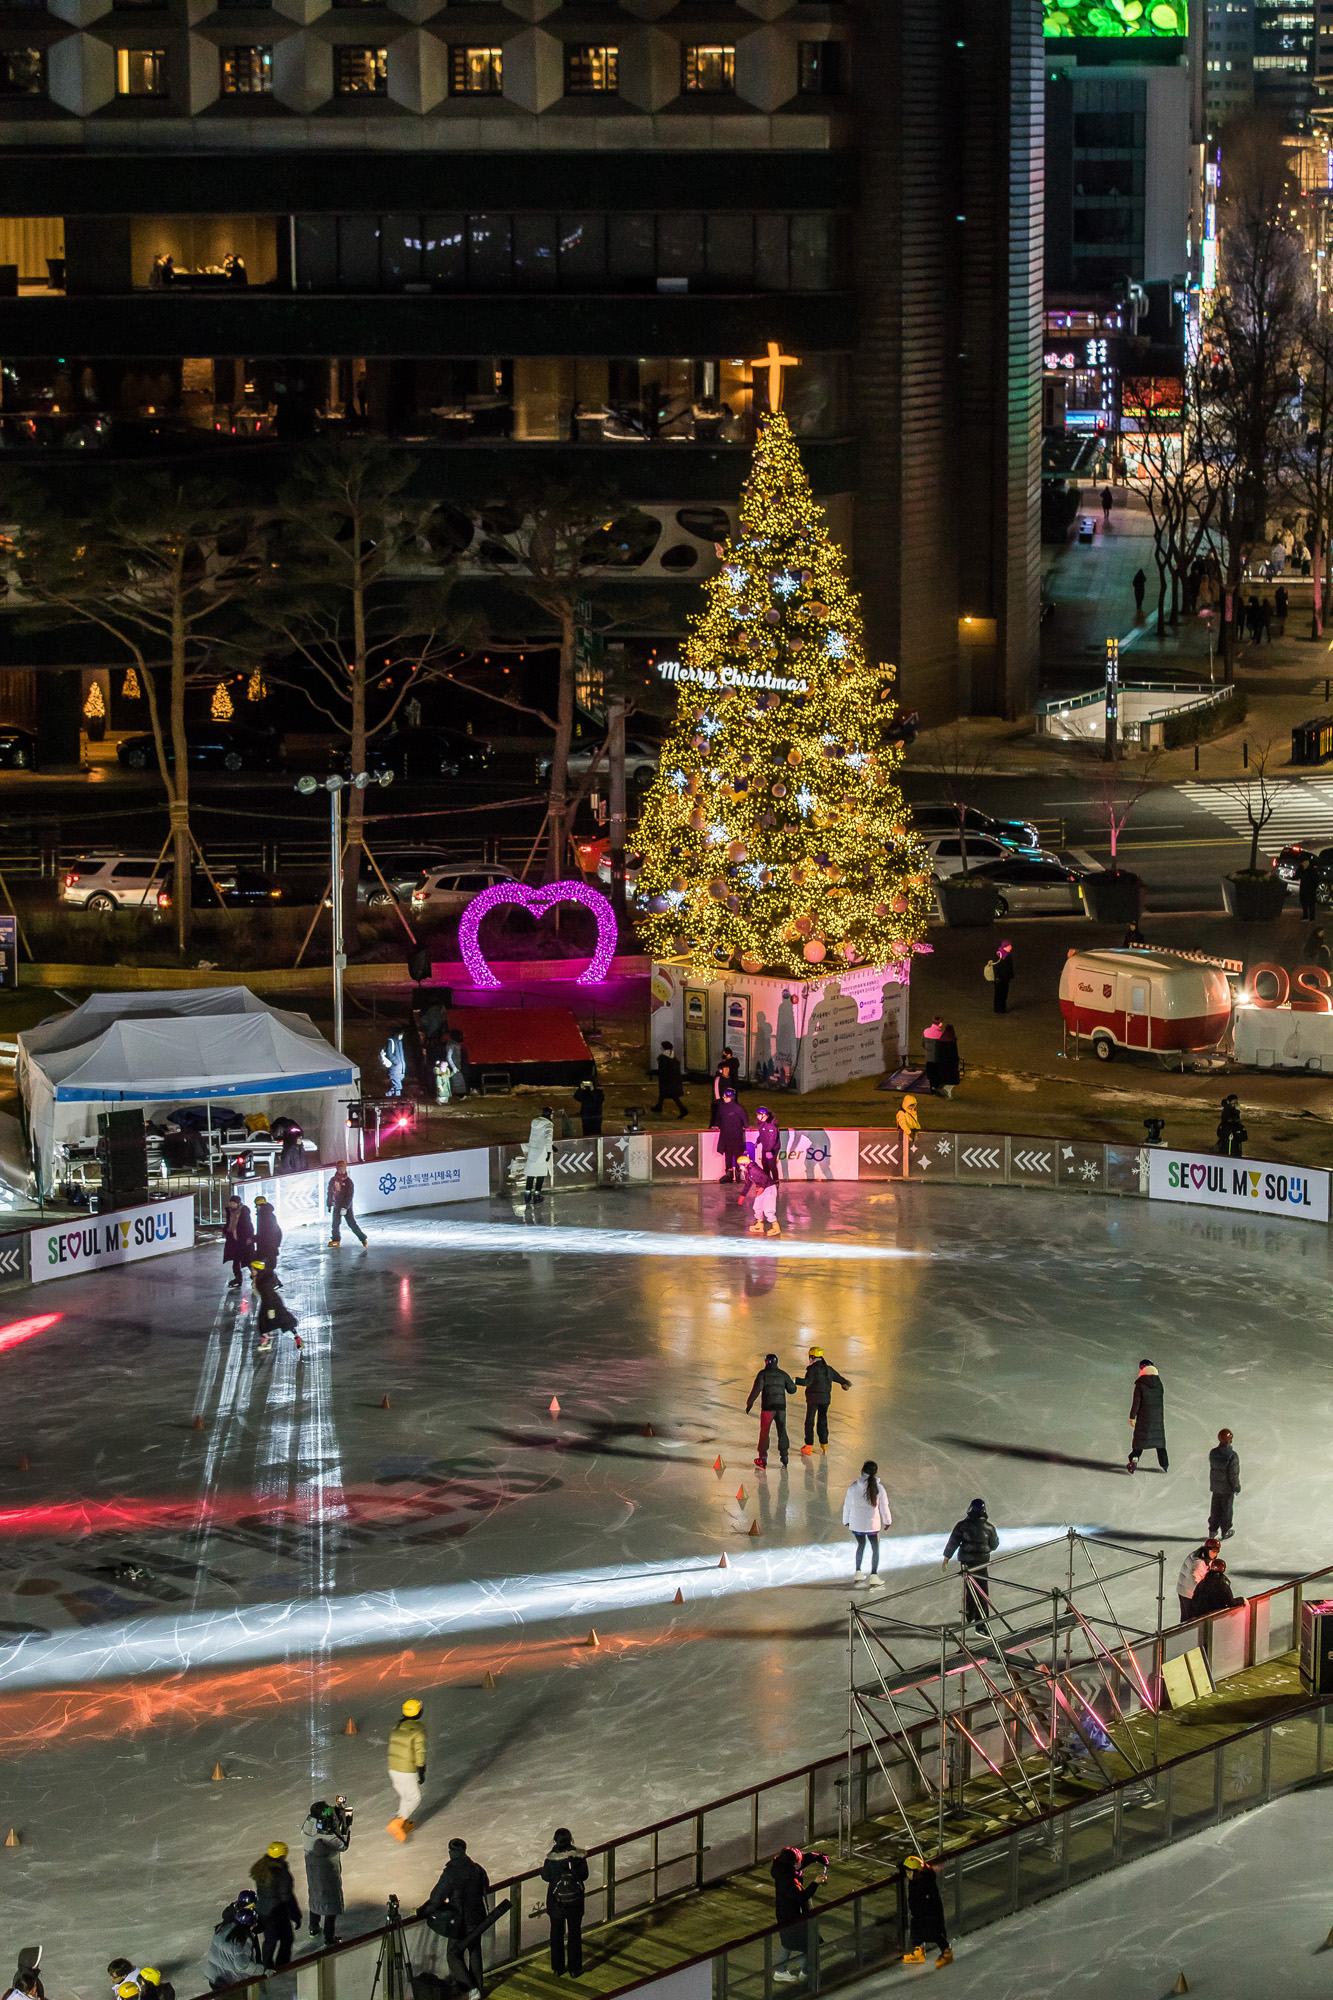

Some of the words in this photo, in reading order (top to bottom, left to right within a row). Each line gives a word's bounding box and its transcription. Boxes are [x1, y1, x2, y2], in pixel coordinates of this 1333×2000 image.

[657, 661, 718, 689] Merry
[720, 666, 809, 692] Christmas
[398, 1168, 461, 1185] 서울특별시체육회
[1168, 1161, 1228, 1194] SEOUL
[1265, 1173, 1312, 1206] SOUL
[48, 1228, 101, 1265] SEOUL
[134, 1211, 177, 1247] SOUL
